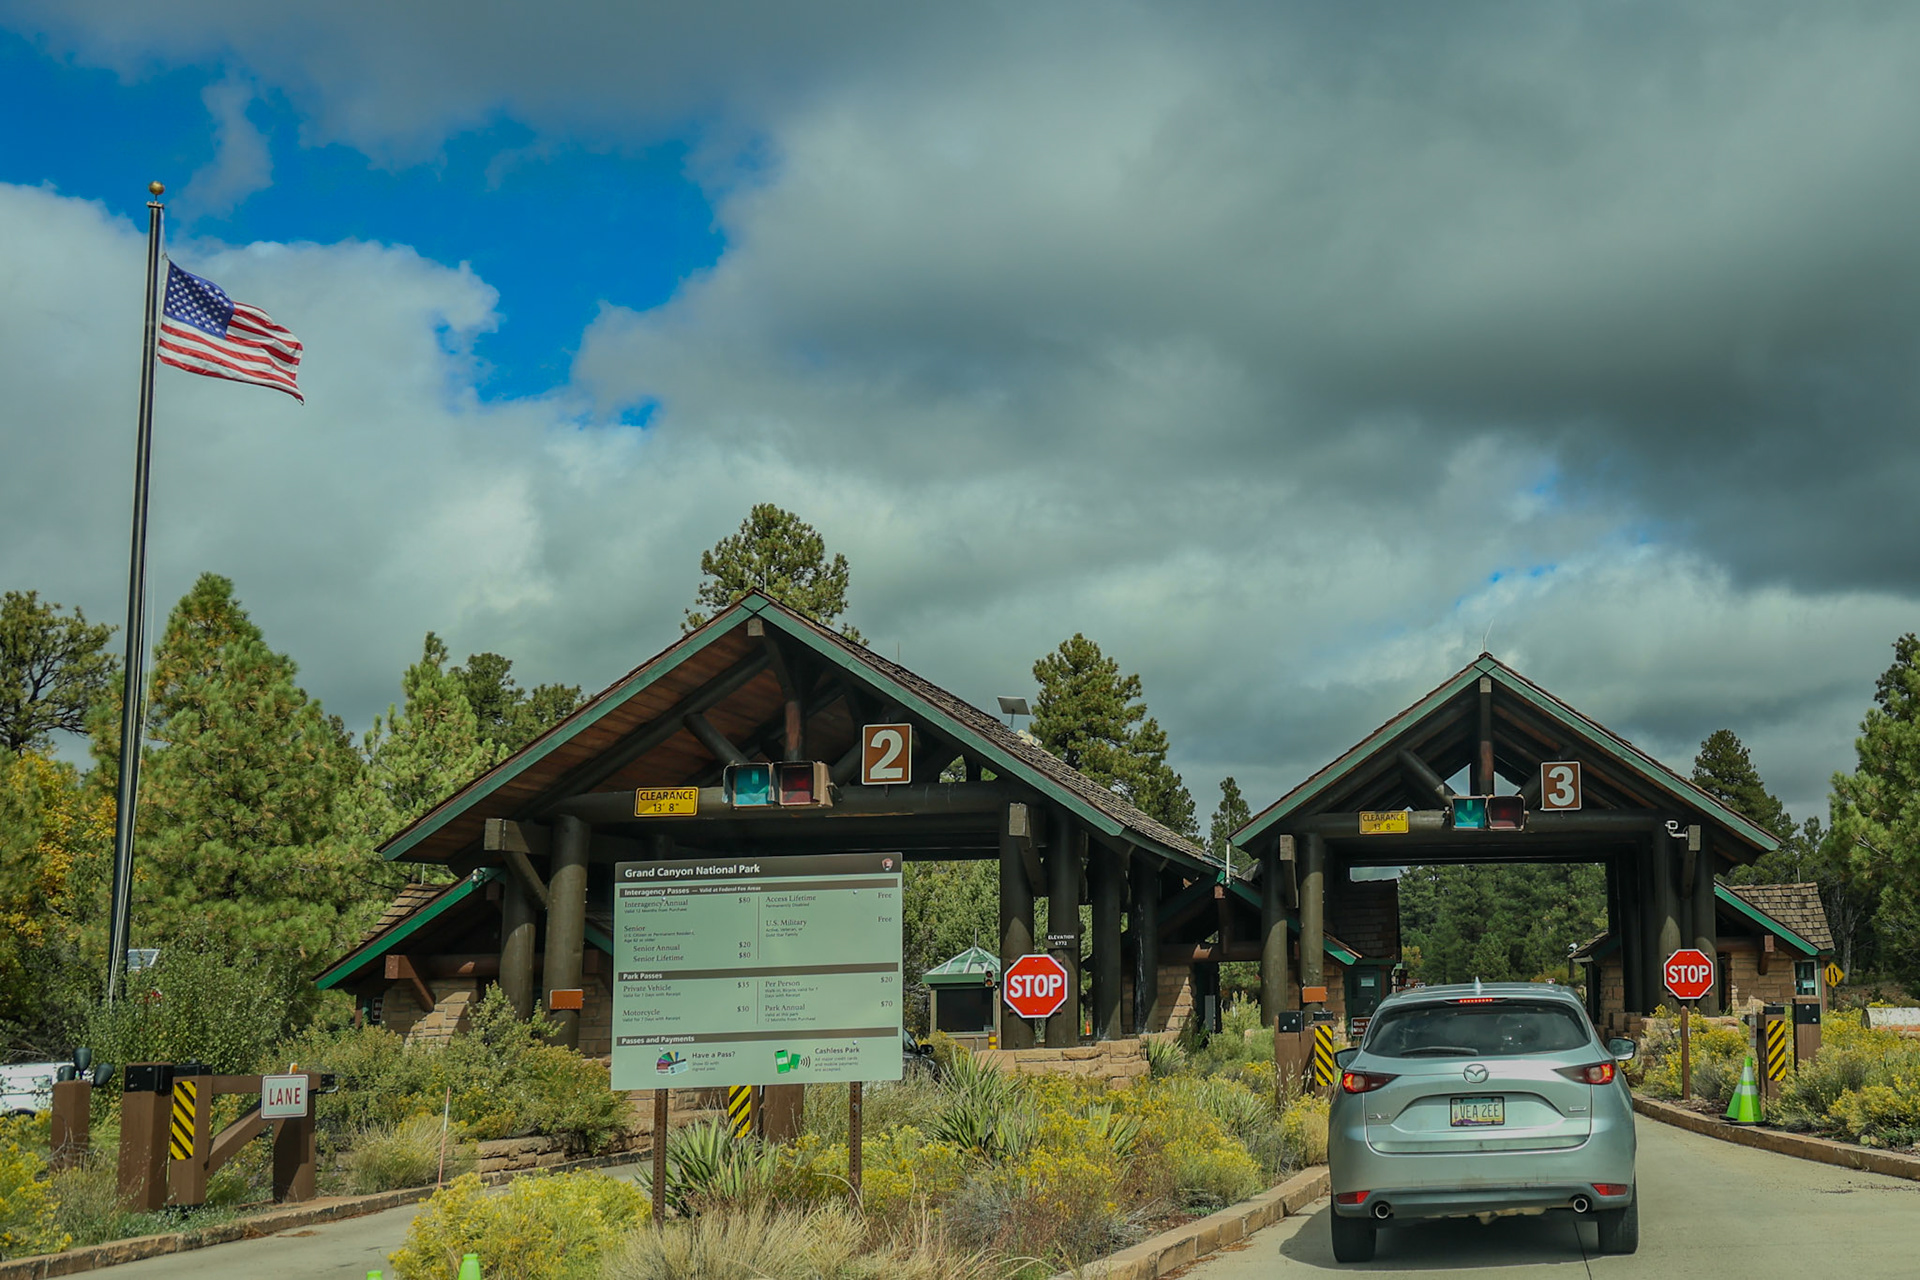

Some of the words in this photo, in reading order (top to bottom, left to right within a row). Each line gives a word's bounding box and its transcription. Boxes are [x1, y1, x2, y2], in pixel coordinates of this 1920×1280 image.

[869, 729, 904, 779] 2
[1548, 766, 1575, 806] 3
[639, 791, 694, 801] CLEARANCE
[1362, 813, 1405, 822] CLEARANCE
[625, 868, 655, 878] Grand
[657, 867, 694, 878] Canyon
[696, 865, 737, 875] National
[739, 864, 760, 873] Park
[624, 889, 666, 897] Interagency
[780, 919, 807, 927] Military
[1668, 965, 1709, 983] STOP
[1009, 974, 1062, 998] STOP
[622, 1009, 660, 1017] Motorcycle
[621, 1037, 644, 1045] Passes
[661, 1035, 695, 1044] Payments
[269, 1087, 301, 1106] LANE
[1460, 1105, 1478, 1118] VEA
